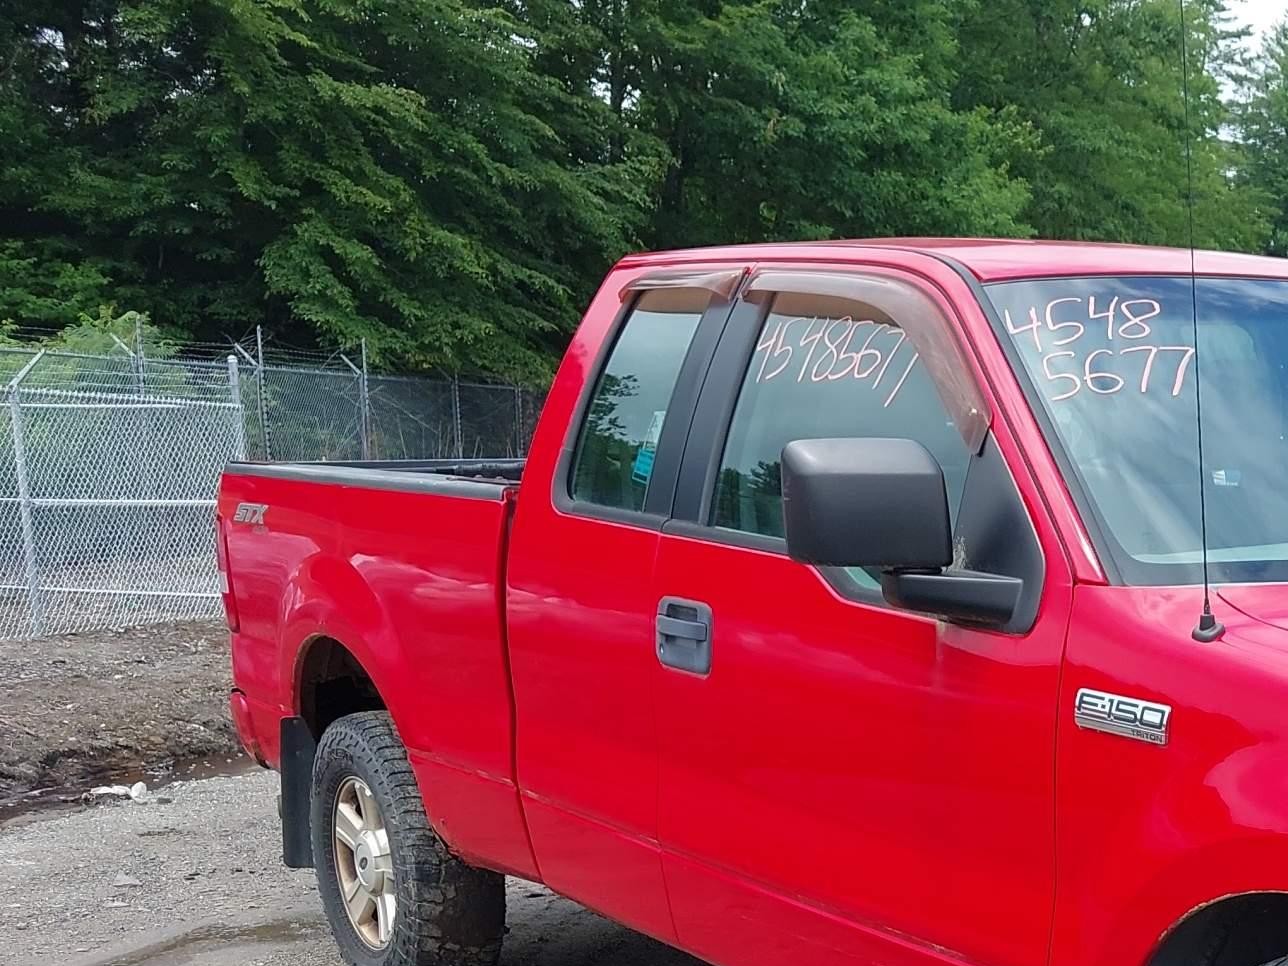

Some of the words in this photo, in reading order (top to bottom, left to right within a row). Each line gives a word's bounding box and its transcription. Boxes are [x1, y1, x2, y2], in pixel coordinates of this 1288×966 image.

[1004, 296, 1161, 353] 4548
[1043, 345, 1196, 401] 5677
[233, 502, 269, 525] STX
[1077, 692, 1166, 730] F-150
